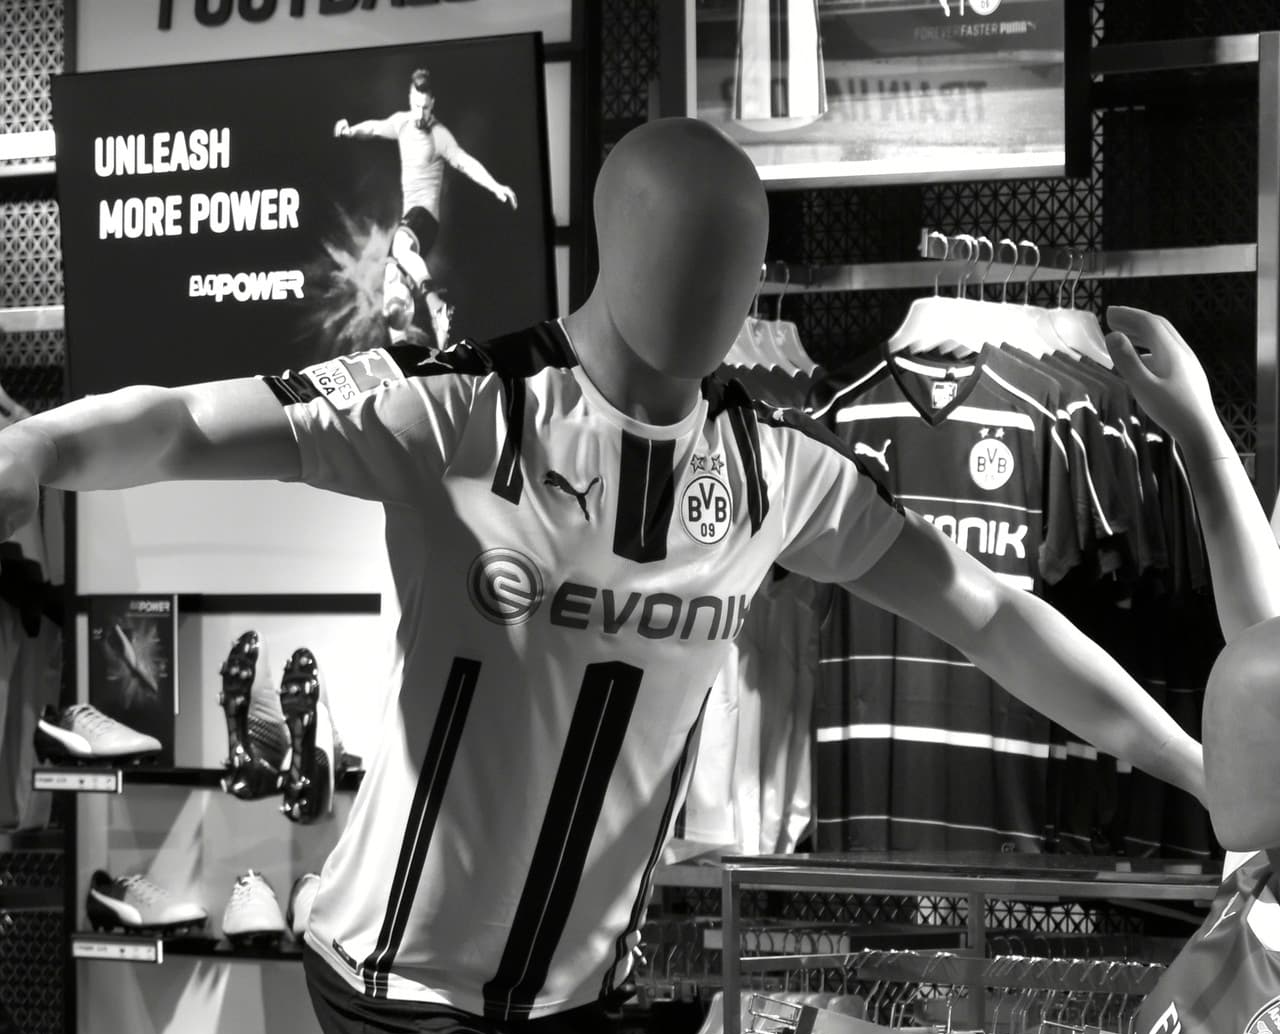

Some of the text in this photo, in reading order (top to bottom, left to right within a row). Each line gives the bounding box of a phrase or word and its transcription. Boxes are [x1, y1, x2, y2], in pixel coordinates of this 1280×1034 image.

[95, 127, 231, 177] UNLEASH
[99, 188, 300, 240] MORE POWER
[312, 366, 336, 396] LIGA
[976, 447, 1007, 474] BVB
[688, 482, 728, 523] BVB
[700, 522, 717, 539] 09
